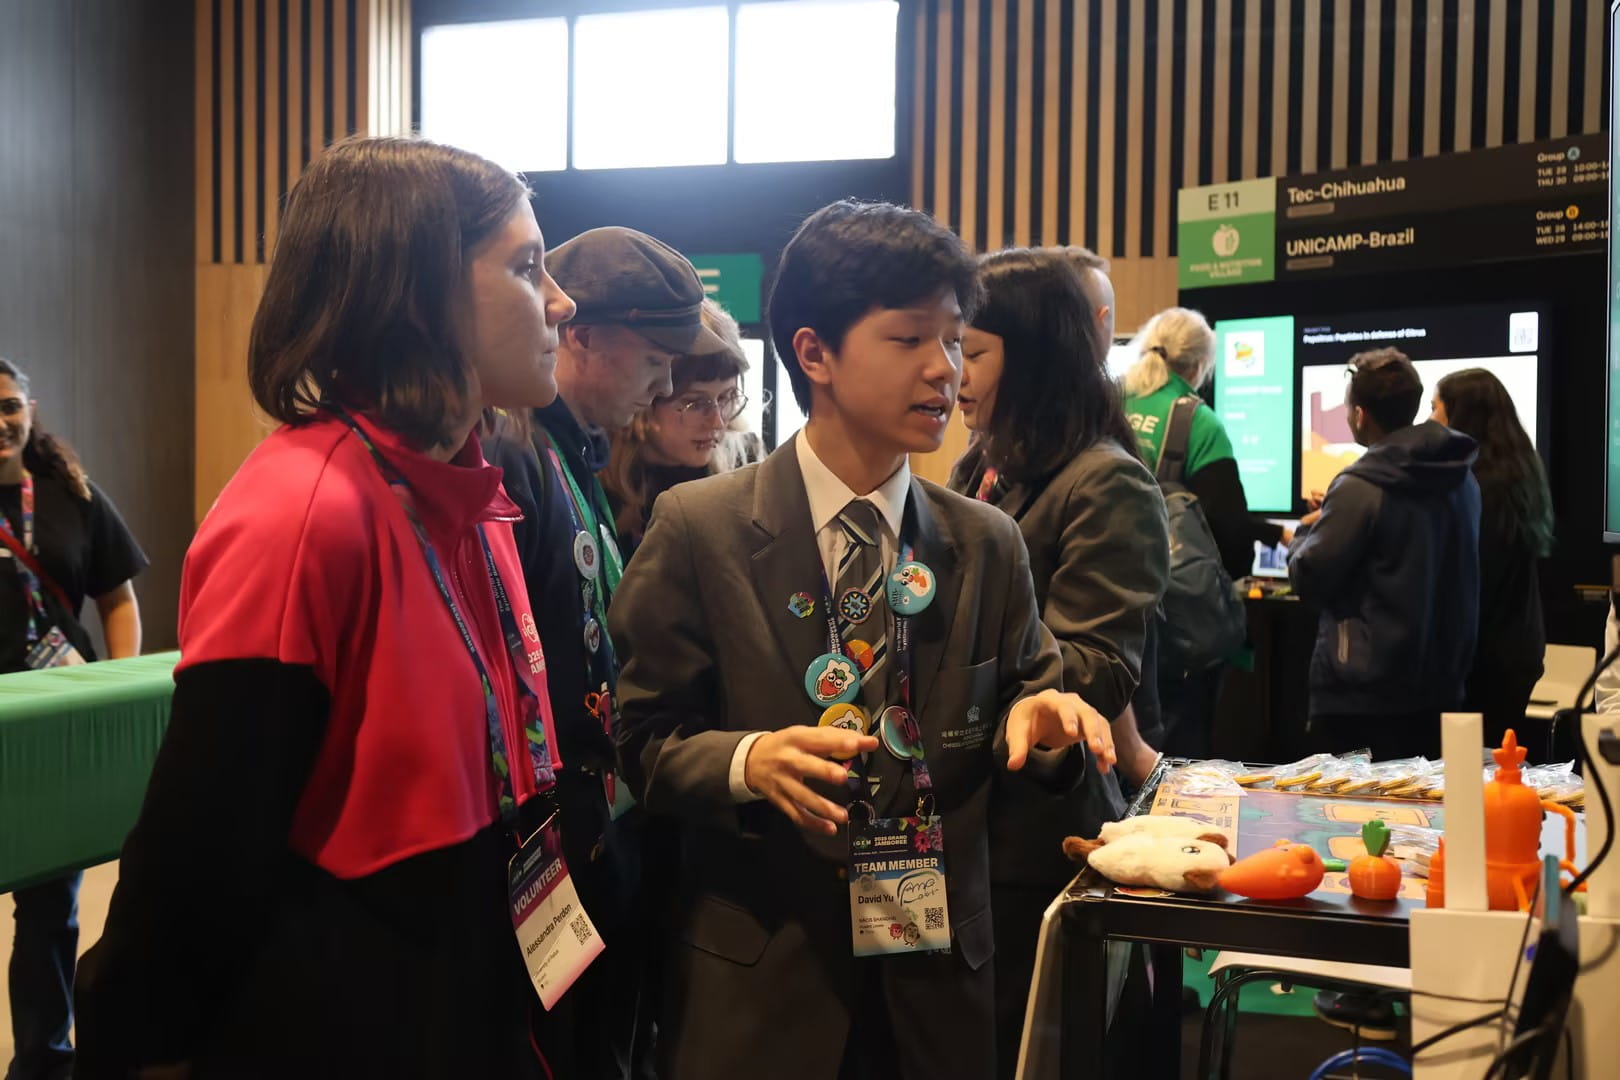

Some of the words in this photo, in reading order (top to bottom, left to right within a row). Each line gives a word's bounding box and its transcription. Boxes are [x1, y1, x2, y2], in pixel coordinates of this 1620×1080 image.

[1537, 151, 1565, 163] Group
[1537, 167, 1553, 177] TUE
[1287, 176, 1406, 203] Tec-Chihuahua
[1208, 193, 1219, 211] E
[1224, 188, 1239, 209] 11
[1536, 225, 1552, 235] TUE
[1286, 227, 1415, 257] UNICAMP-Brazil
[1536, 236, 1554, 245] WED
[1127, 413, 1160, 434] GE
[854, 862, 887, 873] TEAM
[889, 858, 938, 872] MEMBER
[514, 858, 562, 915] VOLUNTEER
[858, 895, 882, 905] David
[883, 895, 894, 904] Yu
[527, 922, 555, 957] Alessandra
[552, 903, 572, 928] Perdon
